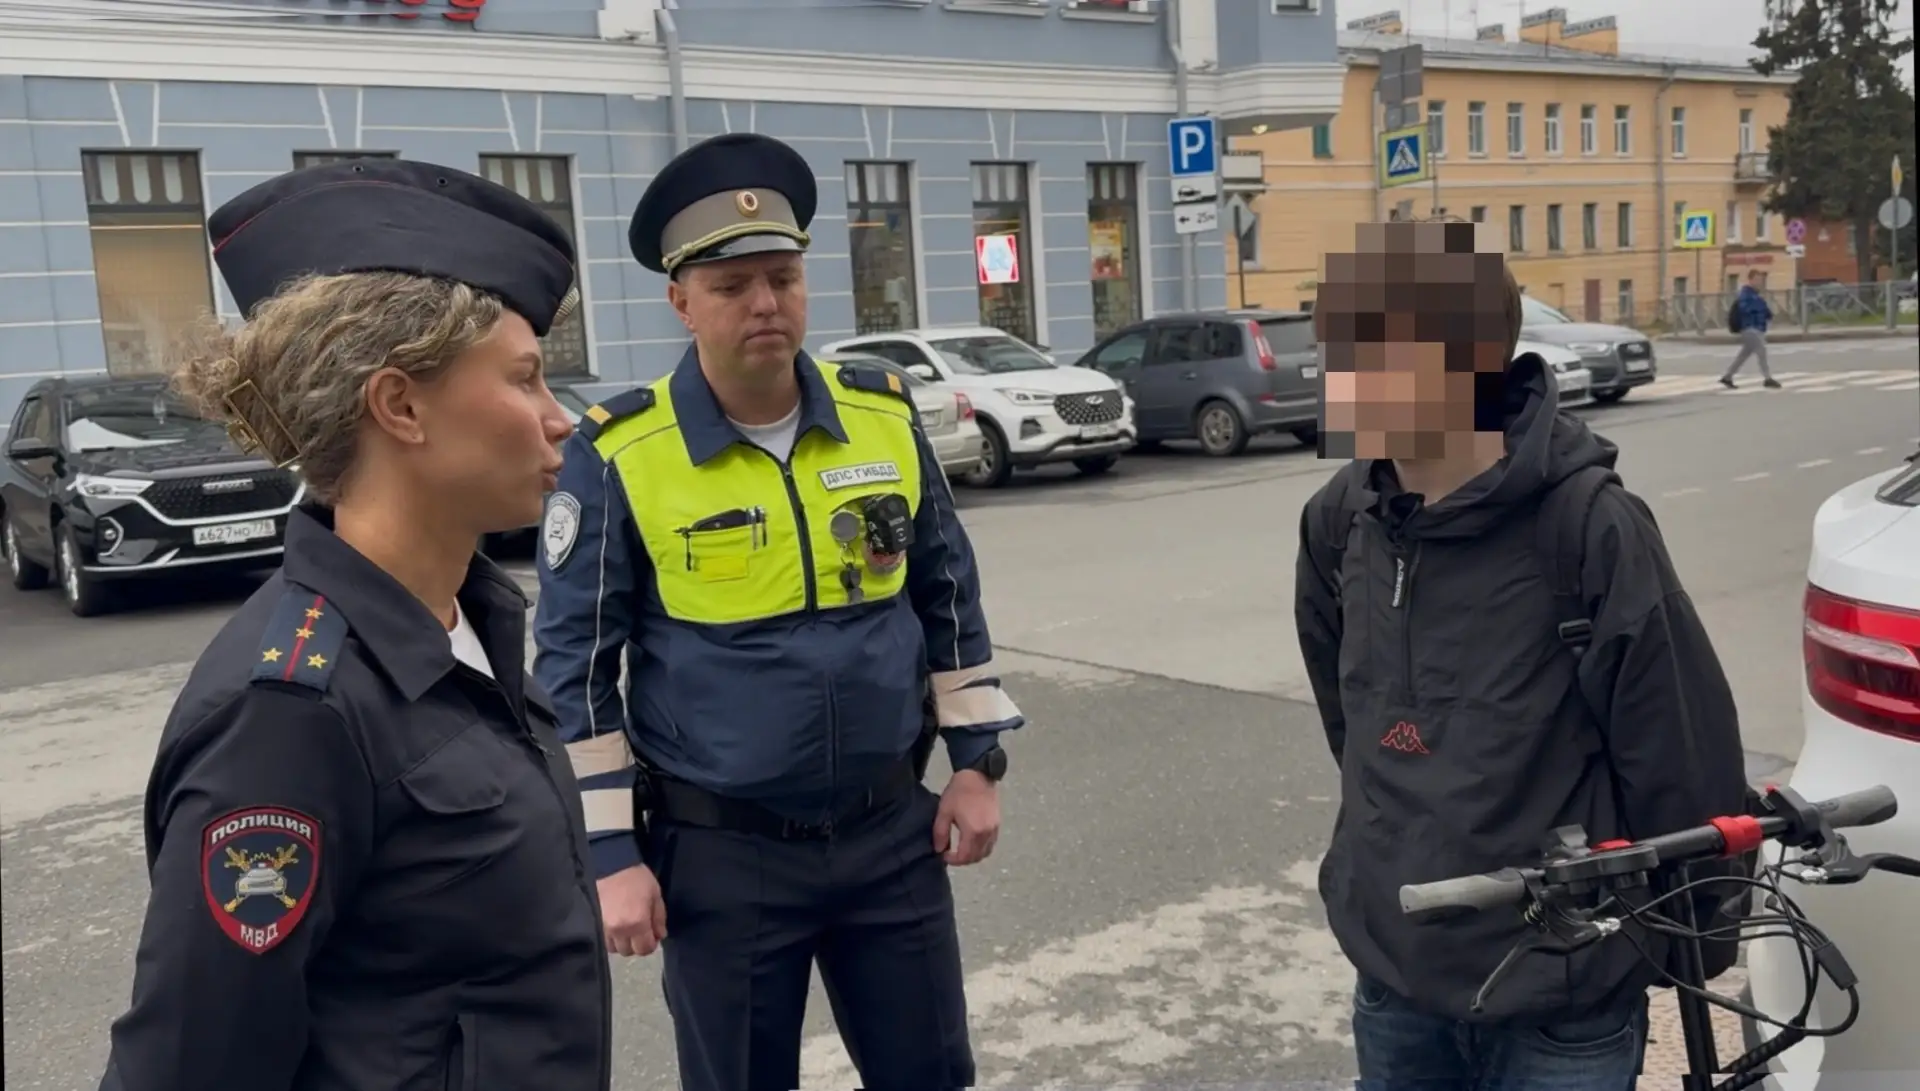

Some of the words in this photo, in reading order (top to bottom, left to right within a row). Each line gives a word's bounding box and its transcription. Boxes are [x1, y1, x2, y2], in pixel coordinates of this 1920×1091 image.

[1180, 125, 1206, 170] P
[825, 470, 853, 485] ДПС
[854, 464, 898, 479] ГИБДД
[211, 814, 312, 845] ПОЛИЦИЯ
[240, 922, 279, 948] МВД
